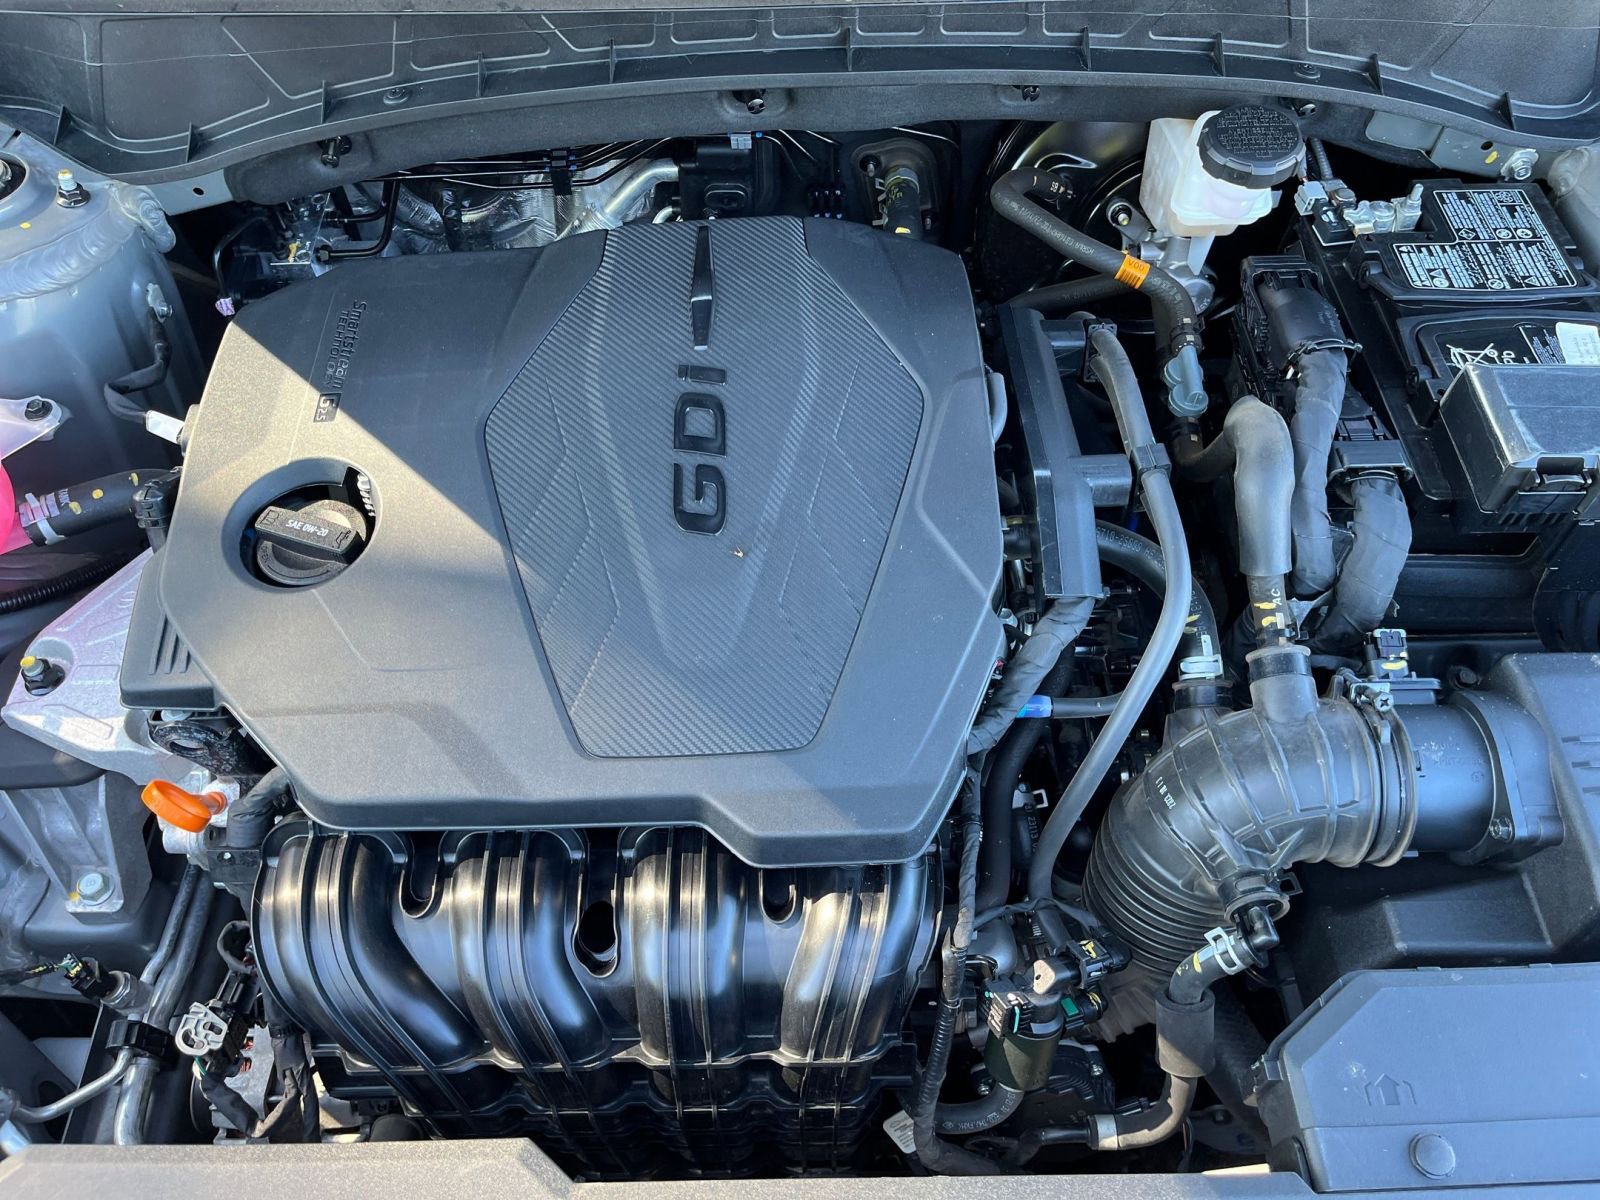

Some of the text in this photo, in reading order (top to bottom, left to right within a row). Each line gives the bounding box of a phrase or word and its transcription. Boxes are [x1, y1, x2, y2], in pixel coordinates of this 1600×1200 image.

[323, 310, 348, 386] TECHNOLOGY
[332, 300, 367, 389] Smartstream
[672, 364, 728, 537] GDi
[285, 519, 303, 530] SAE
